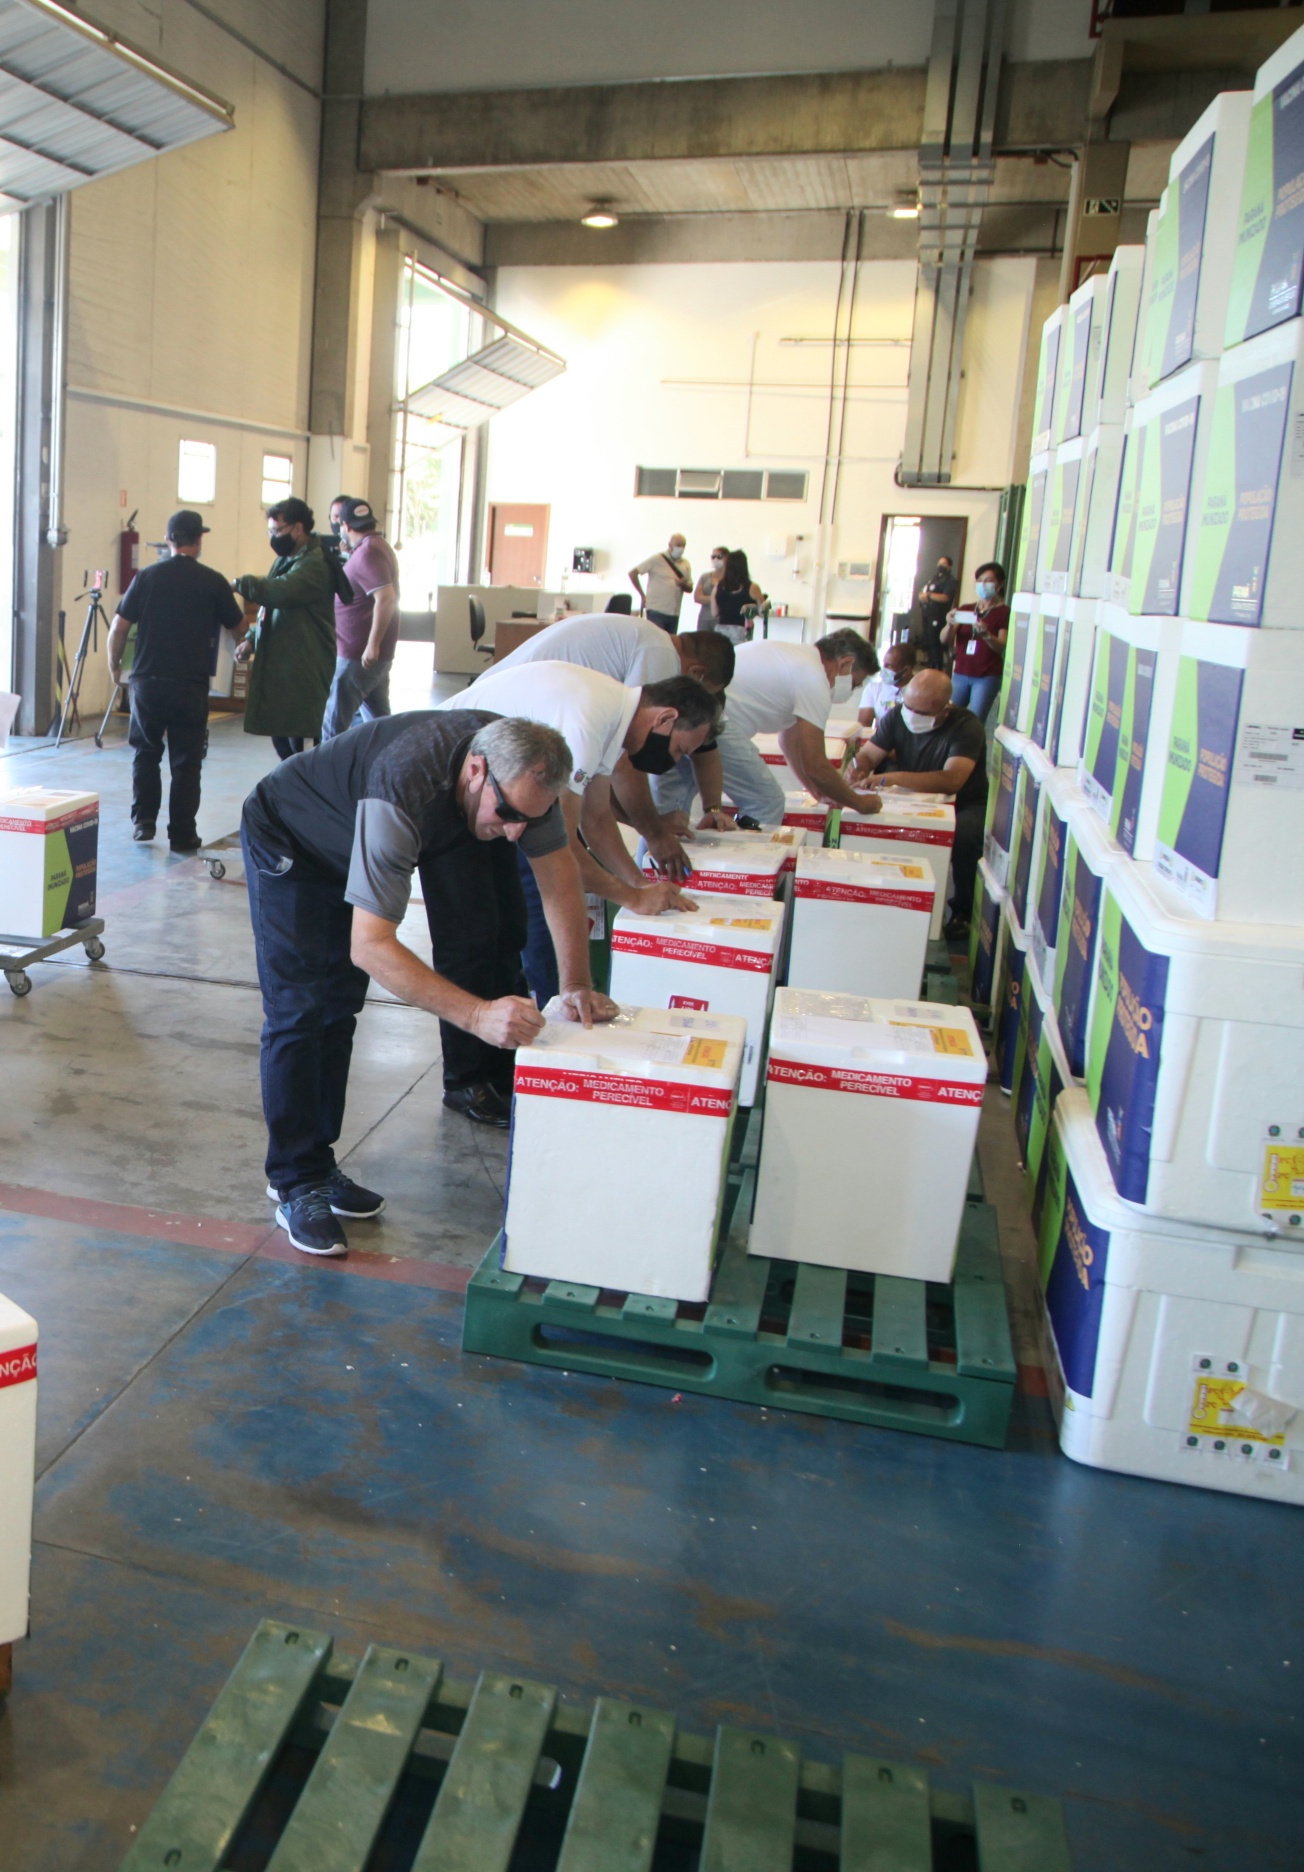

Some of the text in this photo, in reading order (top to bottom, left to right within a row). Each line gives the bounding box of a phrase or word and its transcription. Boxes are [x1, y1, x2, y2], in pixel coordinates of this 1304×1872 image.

[697, 880, 738, 891] ATENÇÃO:
[656, 938, 717, 953] MEDICAMENTO
[516, 1076, 579, 1094] ATENÇÃO:
[583, 1079, 664, 1096] MEDICAMENTO
[831, 1070, 912, 1088] MEDICAMENTO
[840, 1081, 900, 1096] PERECÍVEL
[592, 1091, 653, 1107] PERECÍVEL
